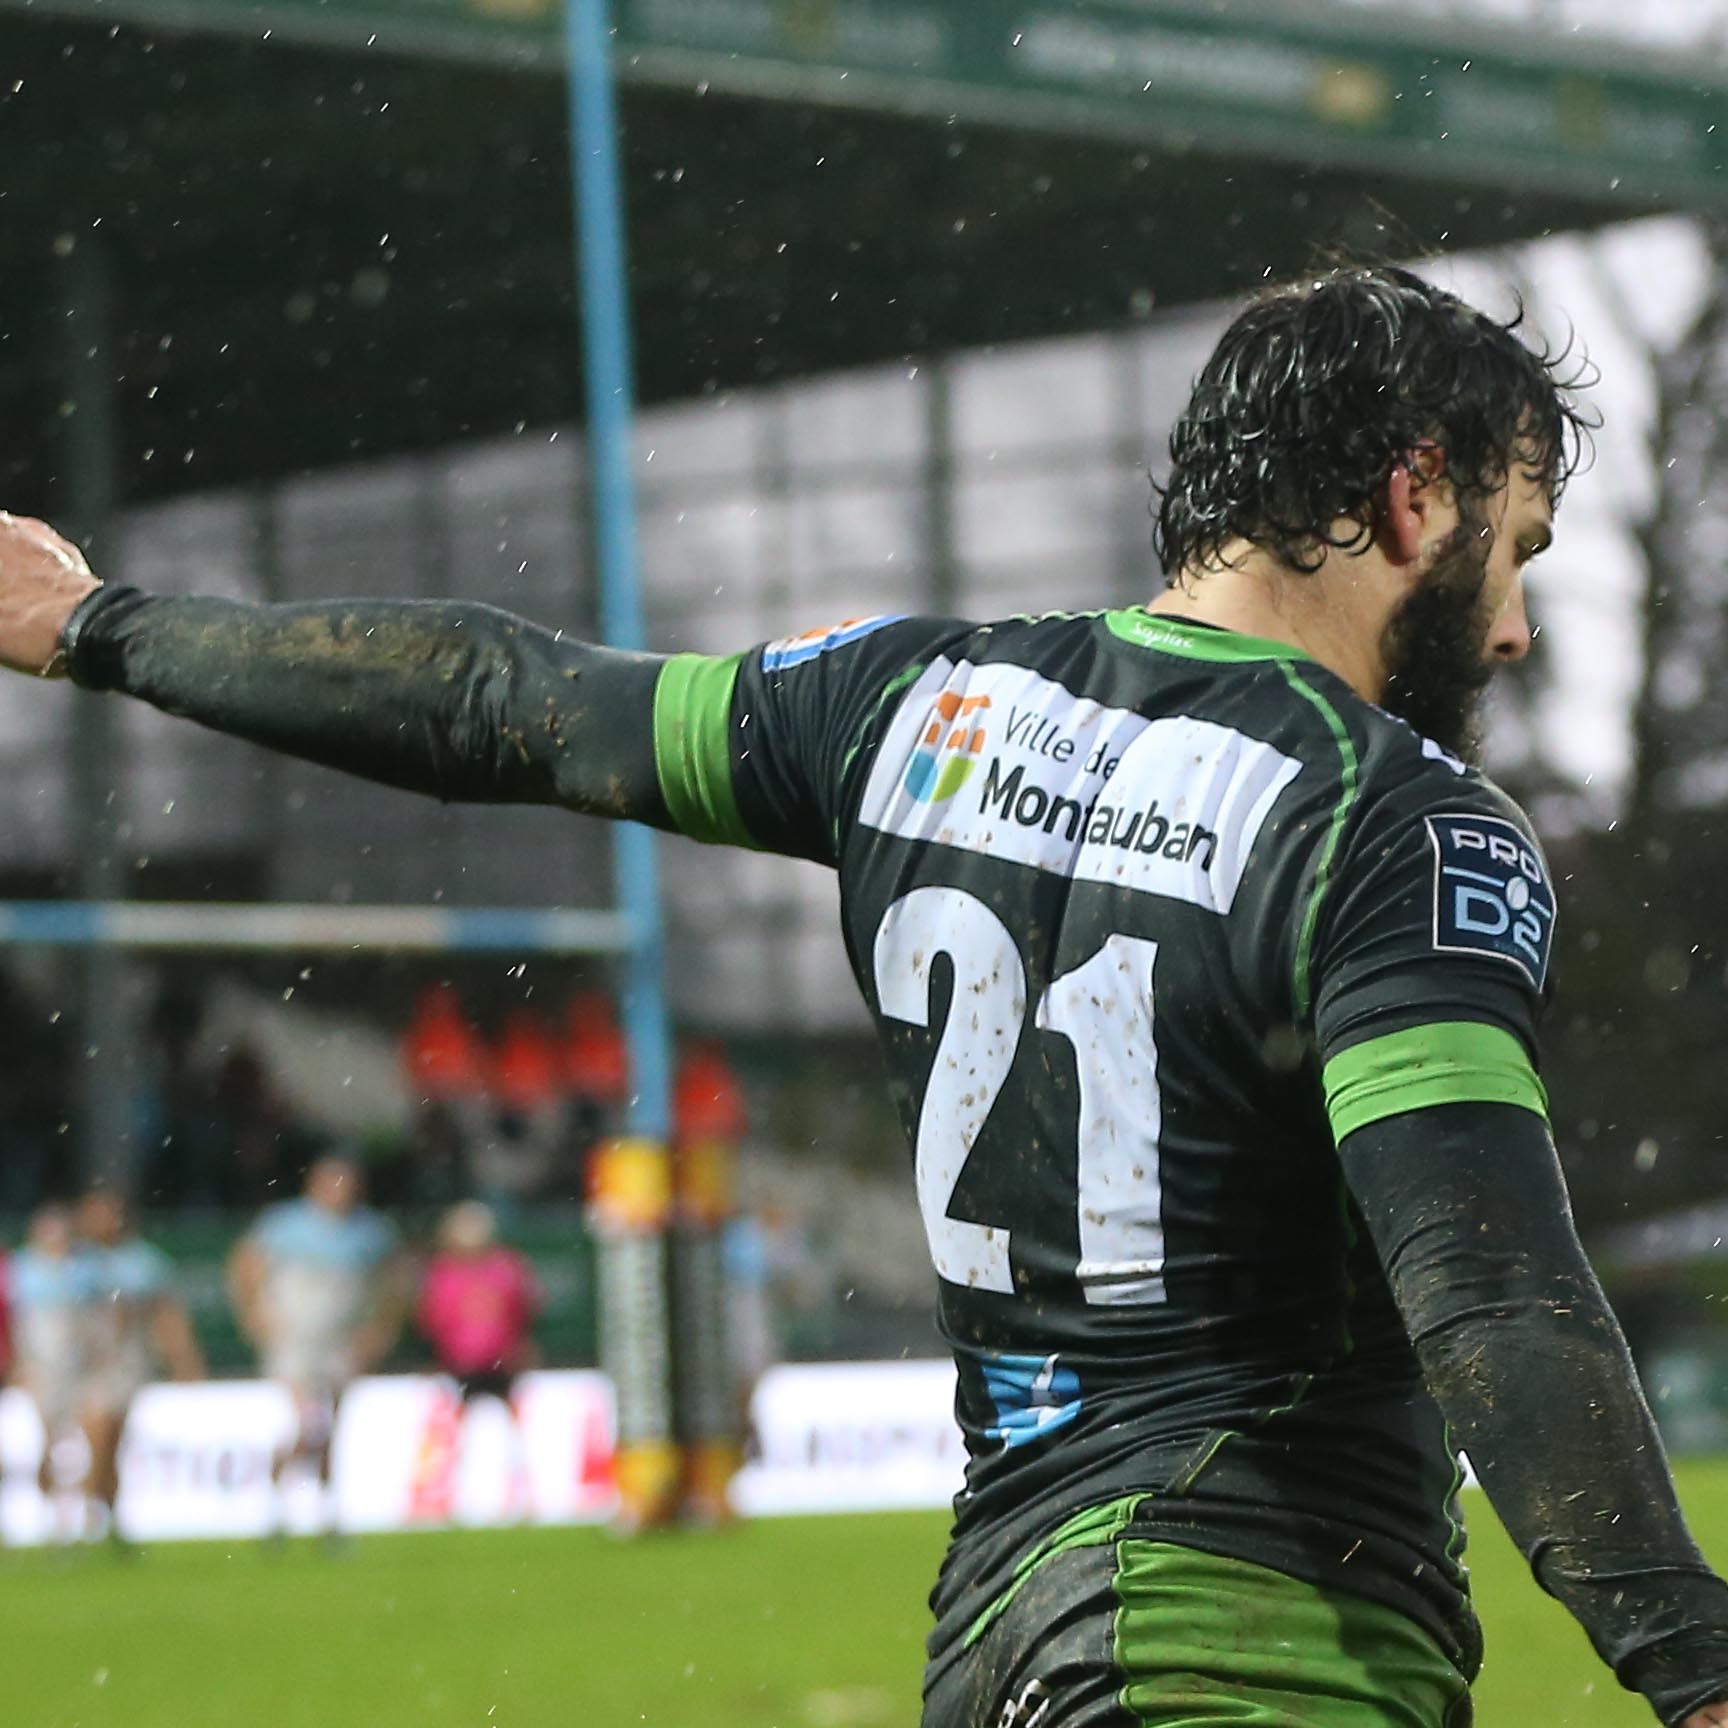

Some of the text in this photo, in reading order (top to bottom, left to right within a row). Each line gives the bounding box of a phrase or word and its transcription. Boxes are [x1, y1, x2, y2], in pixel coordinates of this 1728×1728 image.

[1003, 705, 1119, 781] Ville de
[978, 756, 1219, 872] Montauban
[1450, 828, 1543, 885] PRO
[1454, 884, 1543, 965] D2
[873, 885, 1168, 1307] 21
